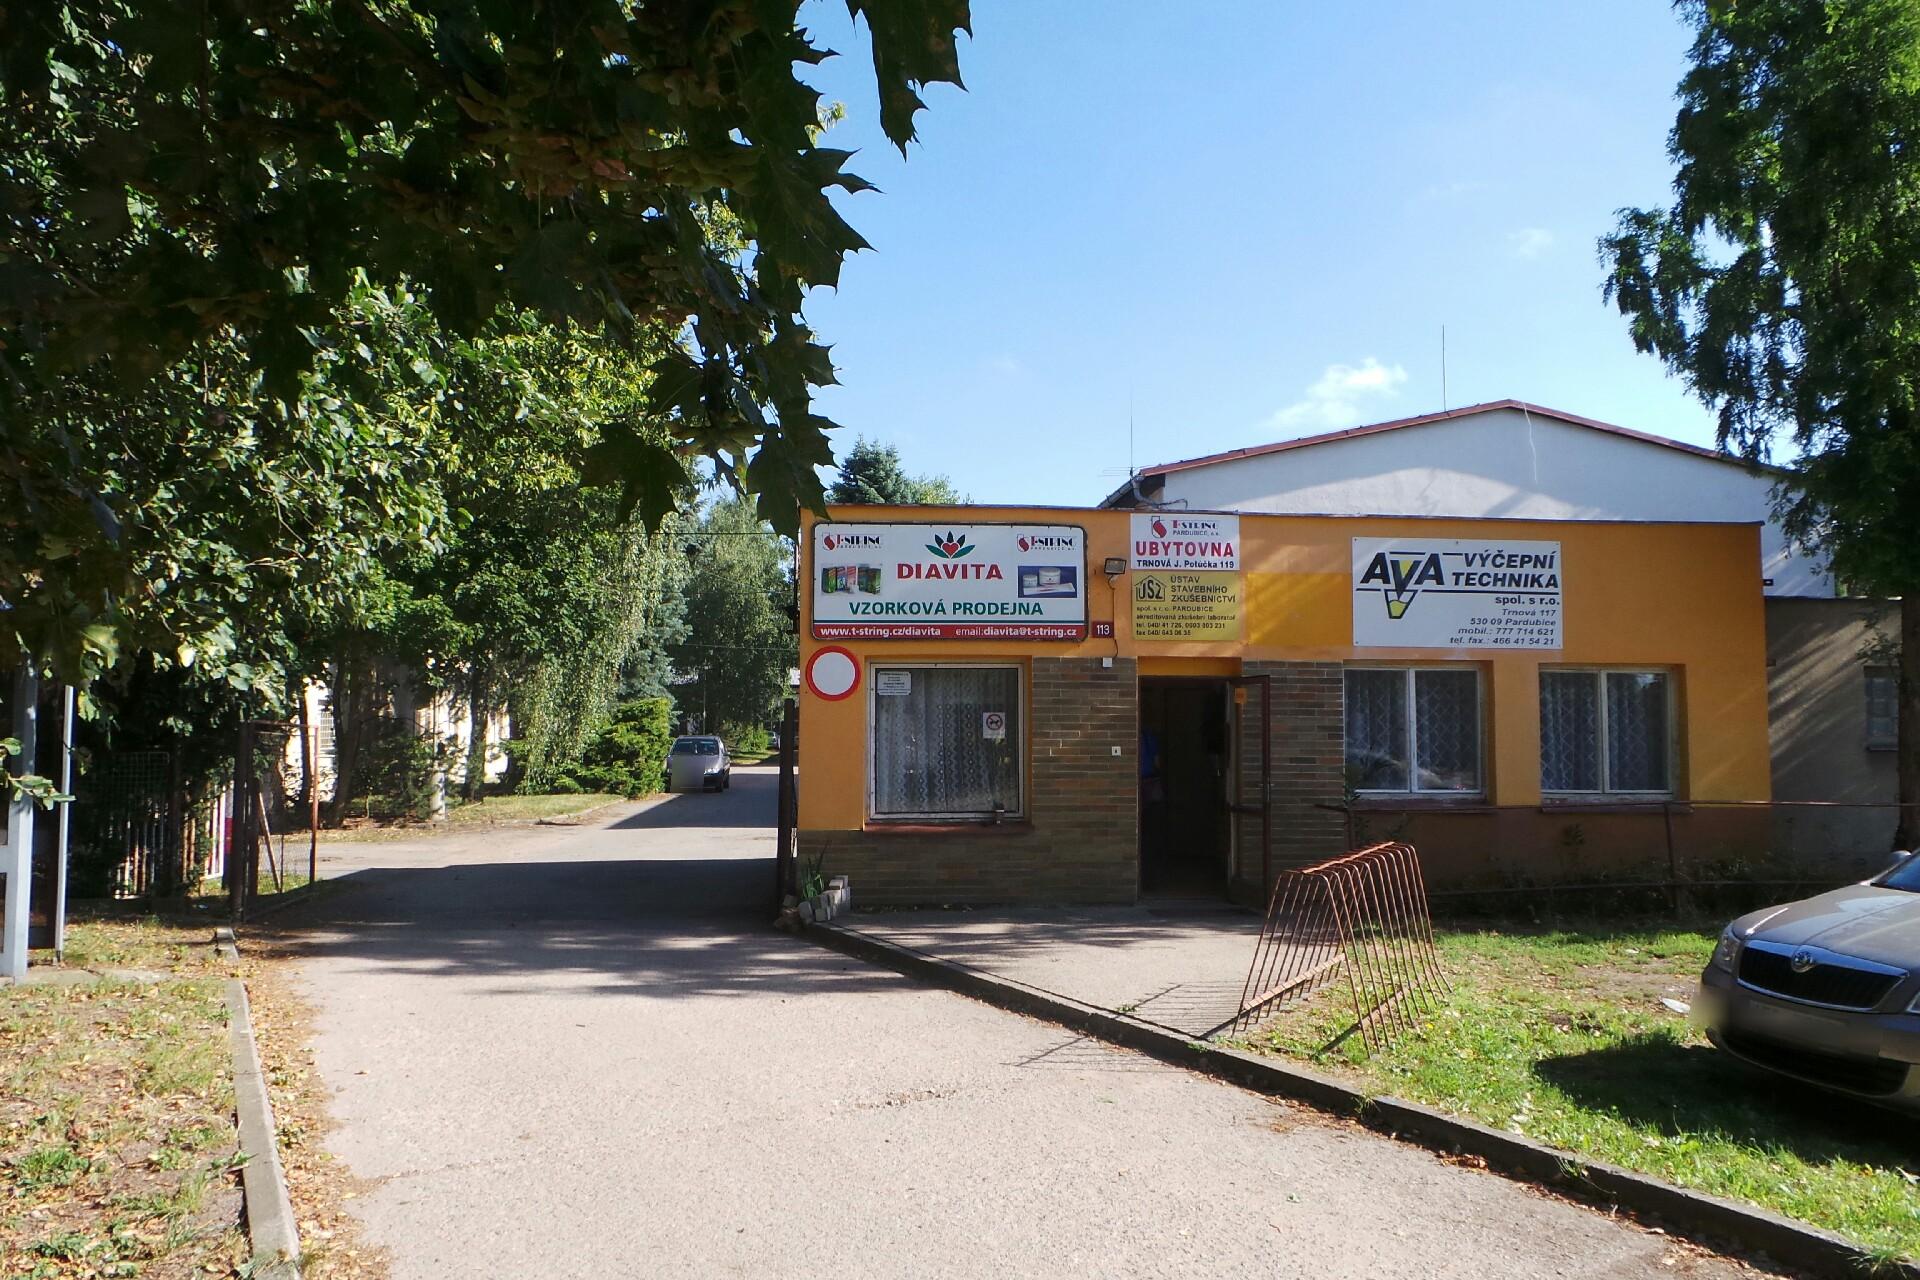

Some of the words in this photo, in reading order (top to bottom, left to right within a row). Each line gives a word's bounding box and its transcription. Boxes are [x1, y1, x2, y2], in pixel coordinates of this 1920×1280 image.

[1135, 541, 1234, 557] UBYTOVNA
[1136, 558, 1171, 568] TRNOVÁ
[1174, 560, 1182, 568] J.
[1464, 549, 1558, 569] VÝČEPNÍ
[896, 563, 1004, 580] DIAVITA
[1359, 552, 1446, 600] AVA
[1452, 572, 1559, 588] TECHNIKA
[1171, 584, 1228, 594] STAVEBNÍHO
[1171, 594, 1236, 603] ZKUŠEBNICTVÍ
[1495, 595, 1526, 606] spol.
[1528, 597, 1536, 605] s
[1539, 597, 1560, 605] r.o.
[849, 599, 947, 615] VZORKOVÁ
[952, 602, 1044, 615] PRODEJNA
[1502, 608, 1537, 616] Trnová
[1540, 609, 1557, 617] 117
[1470, 617, 1488, 625] 530
[1490, 617, 1503, 625] 09
[1505, 618, 1557, 626] Pardubice
[820, 626, 941, 637] www.t-string.cz/diavita
[955, 626, 1077, 638] email:diavita@t-string.cz
[1096, 624, 1110, 636] 113
[1496, 627, 1514, 635] 777
[1517, 628, 1535, 636] 714
[1537, 628, 1555, 636] 621
[1513, 637, 1525, 645] 41
[1528, 637, 1541, 645] 54
[1543, 637, 1555, 645] 21
